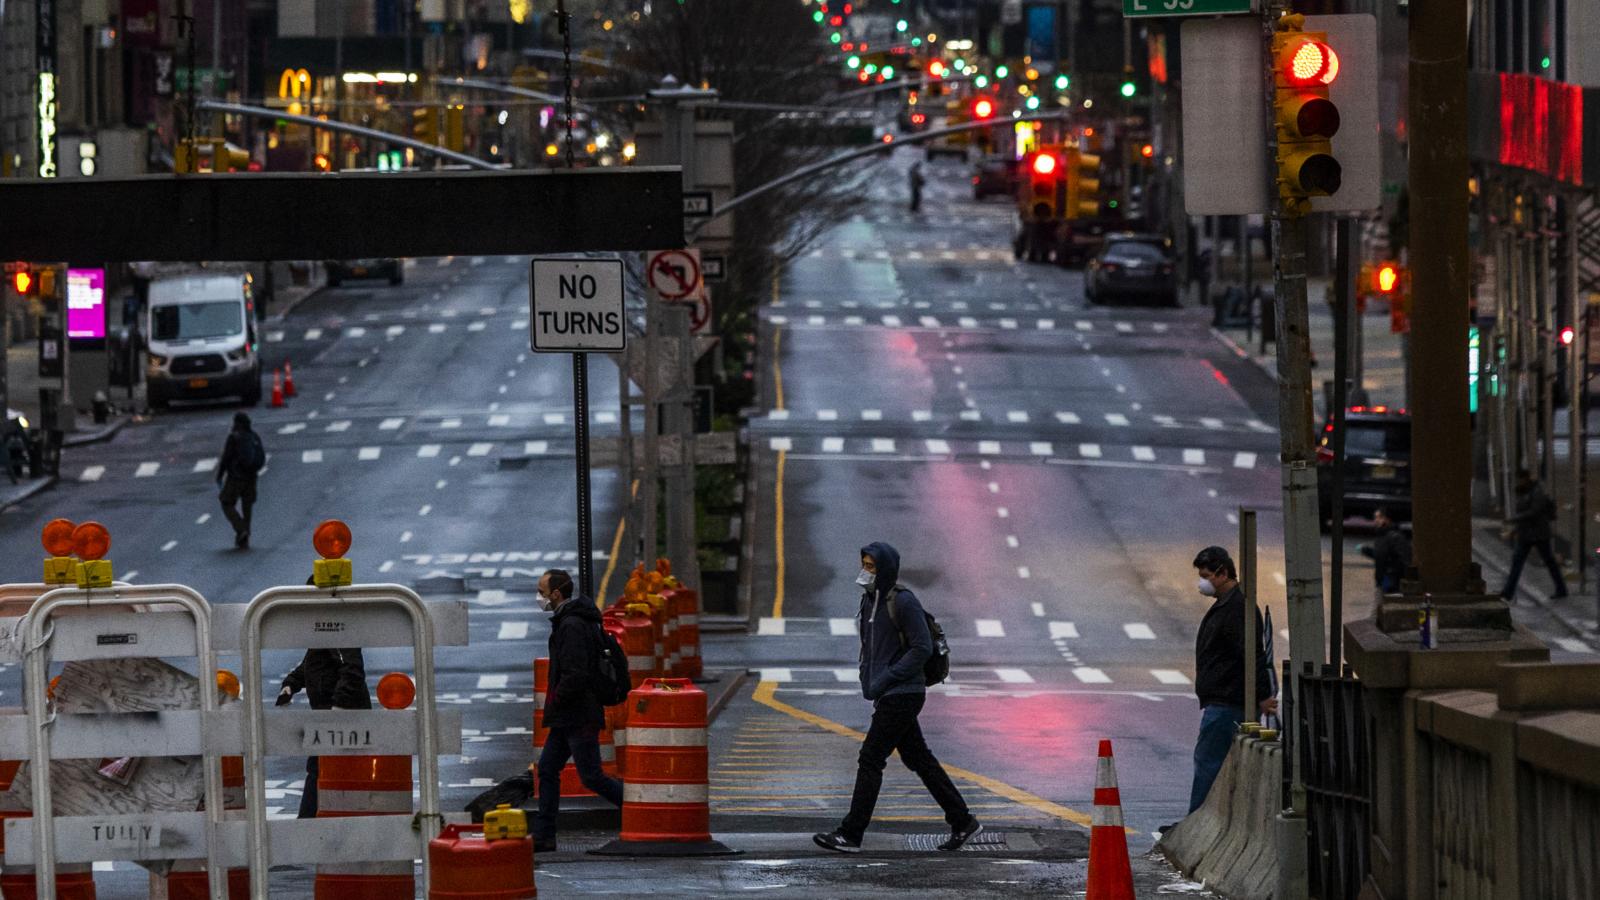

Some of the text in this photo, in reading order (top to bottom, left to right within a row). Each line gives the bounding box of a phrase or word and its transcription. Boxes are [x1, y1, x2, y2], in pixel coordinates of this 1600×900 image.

[559, 274, 597, 300] NO
[538, 311, 620, 335] TURNS
[313, 729, 372, 746] TULLY
[92, 825, 152, 841] TULLY
